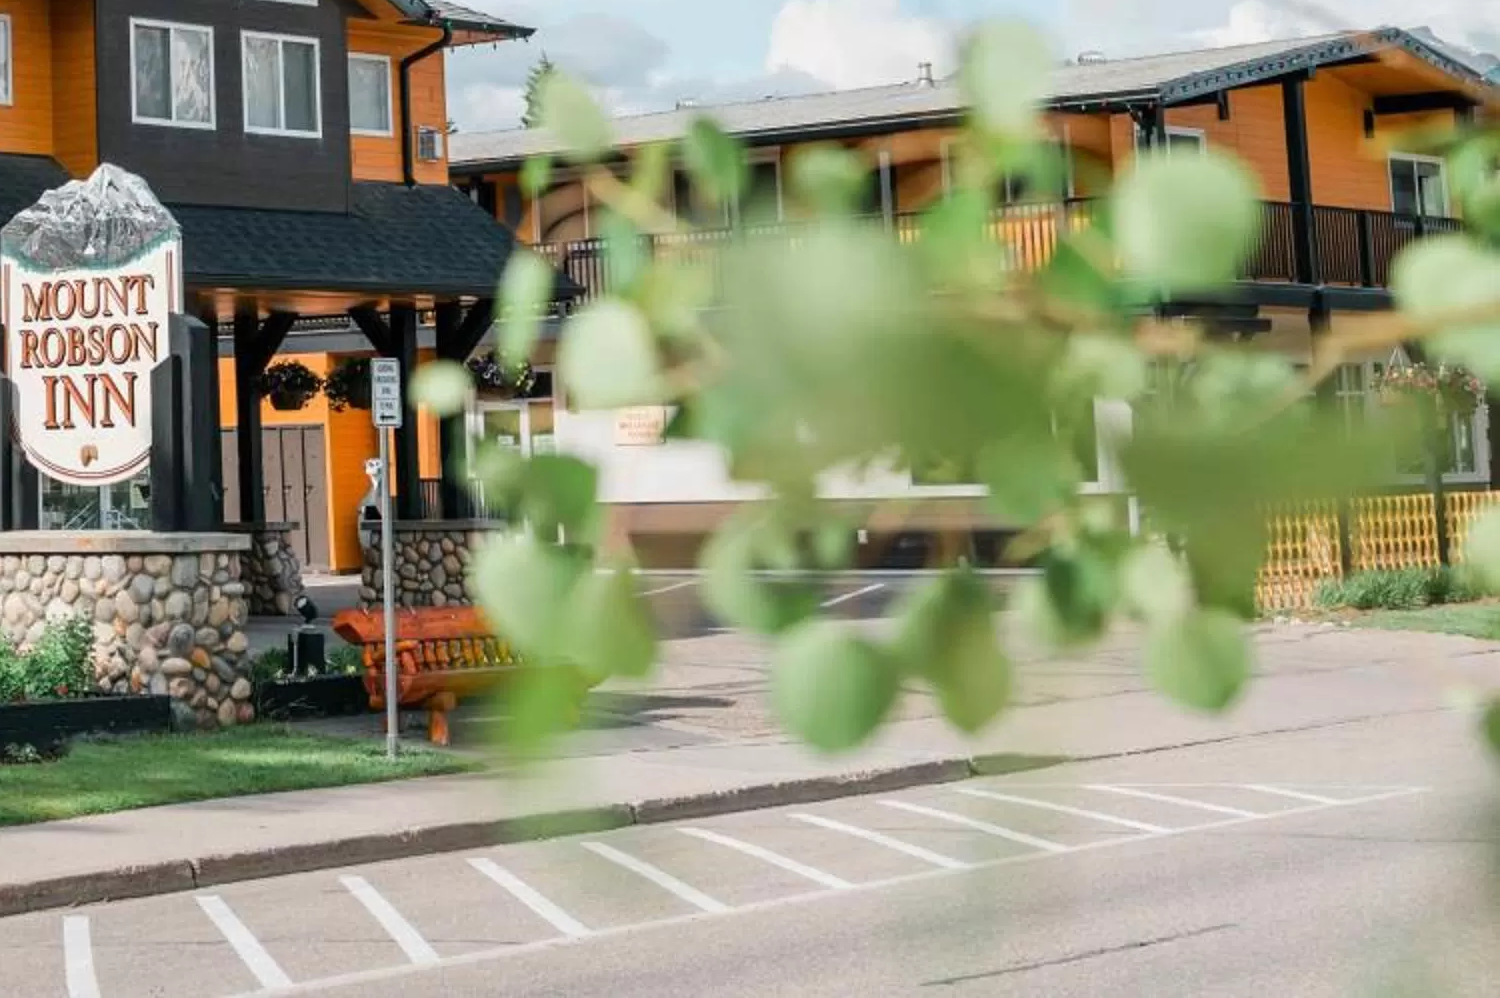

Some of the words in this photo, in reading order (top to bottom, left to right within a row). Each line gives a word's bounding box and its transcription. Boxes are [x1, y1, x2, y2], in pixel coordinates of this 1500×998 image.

[21, 274, 155, 322] MOUNT
[19, 322, 158, 368] ROBSON
[42, 372, 138, 430] INN
